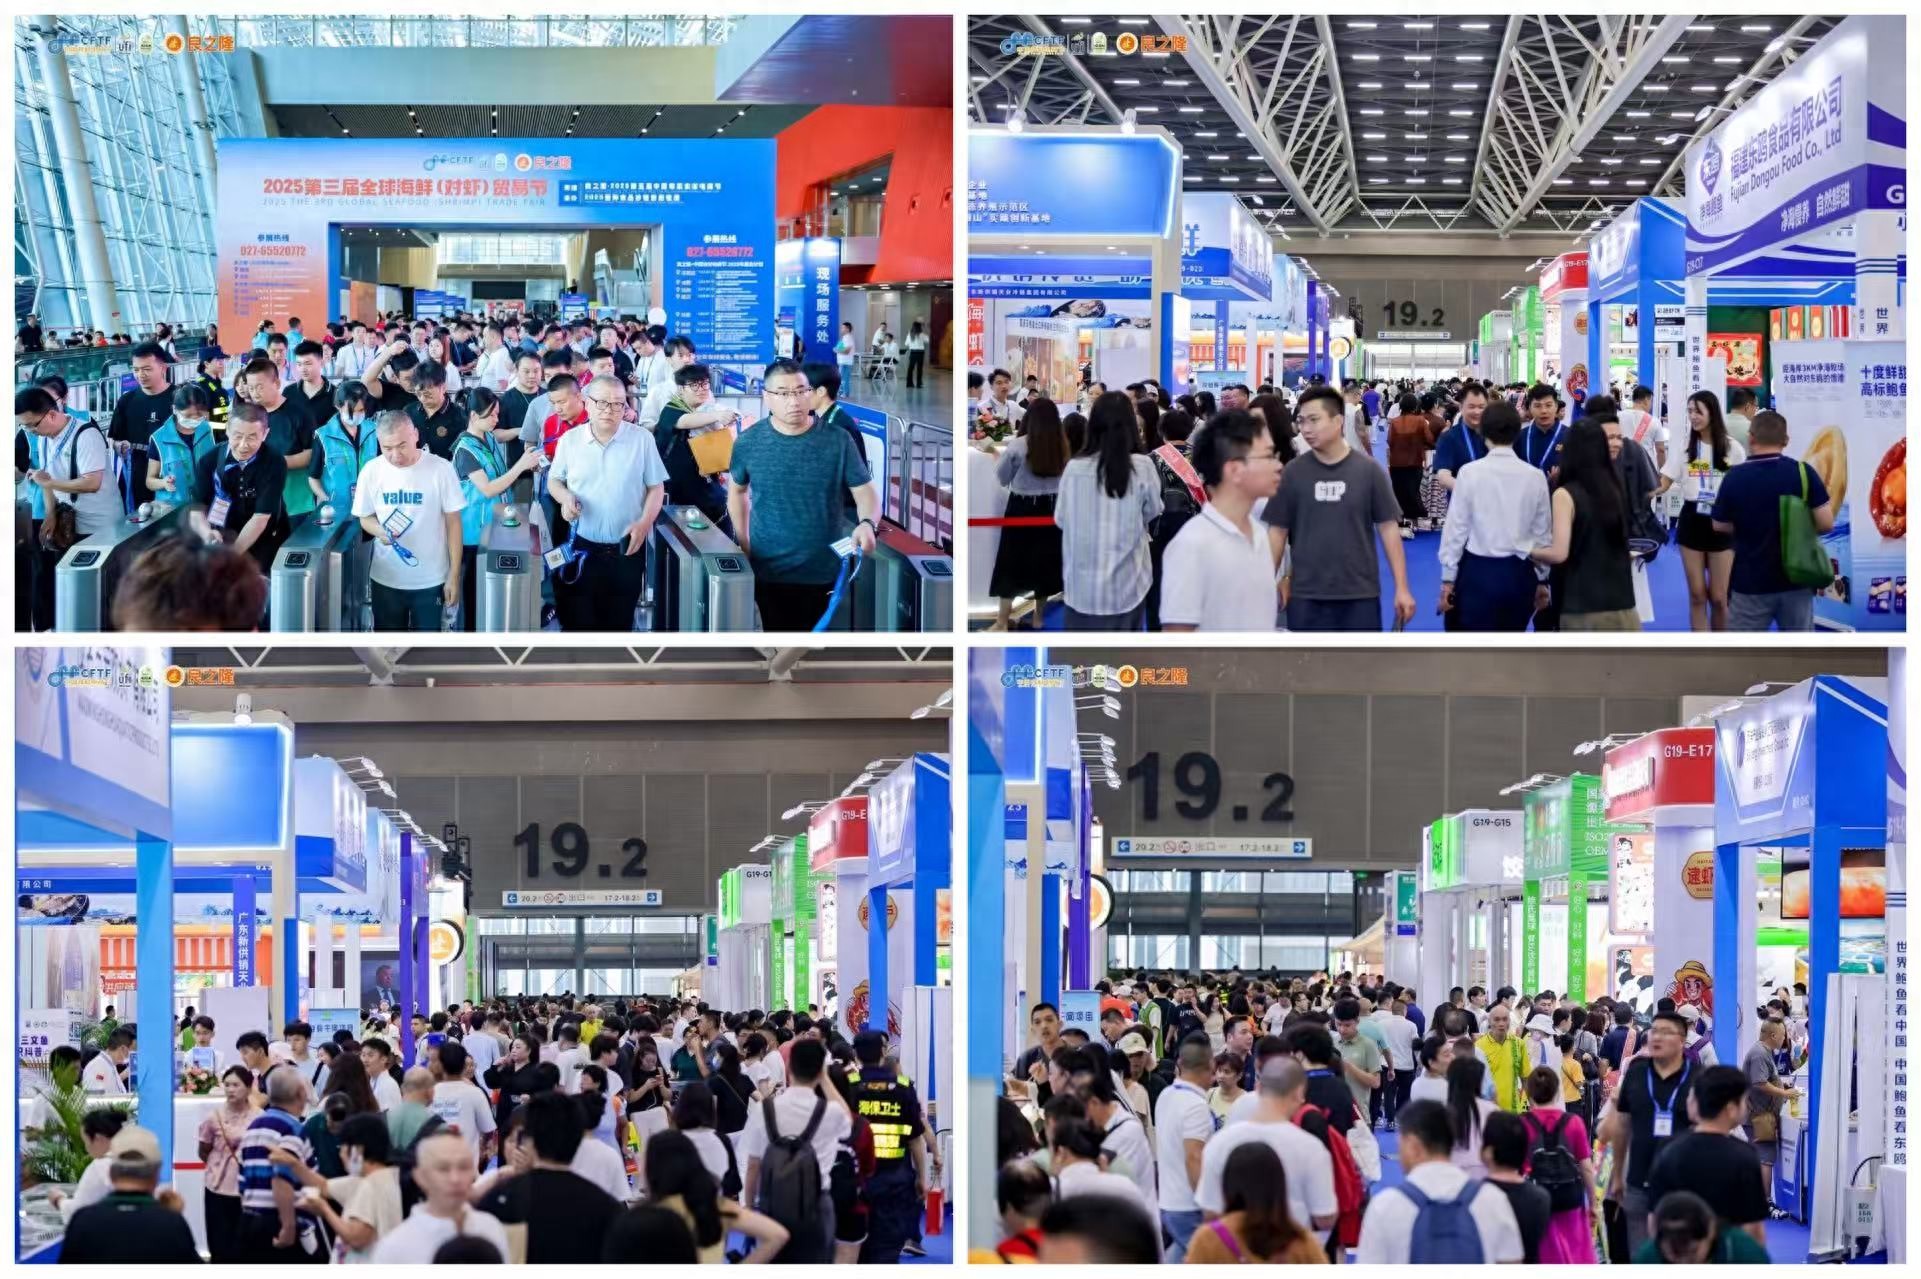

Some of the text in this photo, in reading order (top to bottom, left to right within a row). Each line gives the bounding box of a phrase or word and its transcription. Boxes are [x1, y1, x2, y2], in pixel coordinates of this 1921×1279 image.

[1750, 163, 1780, 192] Dongou
[1781, 144, 1803, 174] Food
[1825, 121, 1842, 150] Ltd
[816, 266, 830, 344] 现场服务处
[1383, 300, 1446, 327] 19.2
[1876, 307, 1888, 335] 世界
[382, 489, 423, 505] value
[1664, 744, 1713, 758] G19-E17
[1128, 751, 1296, 822] 19.2
[841, 809, 867, 820] G19-E
[1473, 818, 1511, 827] G19-G15
[512, 822, 649, 879] 19.2
[17, 879, 52, 889] 限公司
[20, 1035, 49, 1046] 三文鱼
[1894, 940, 1907, 1165] 世界鲍鱼看中国 中国鲍鱼看东鸥
